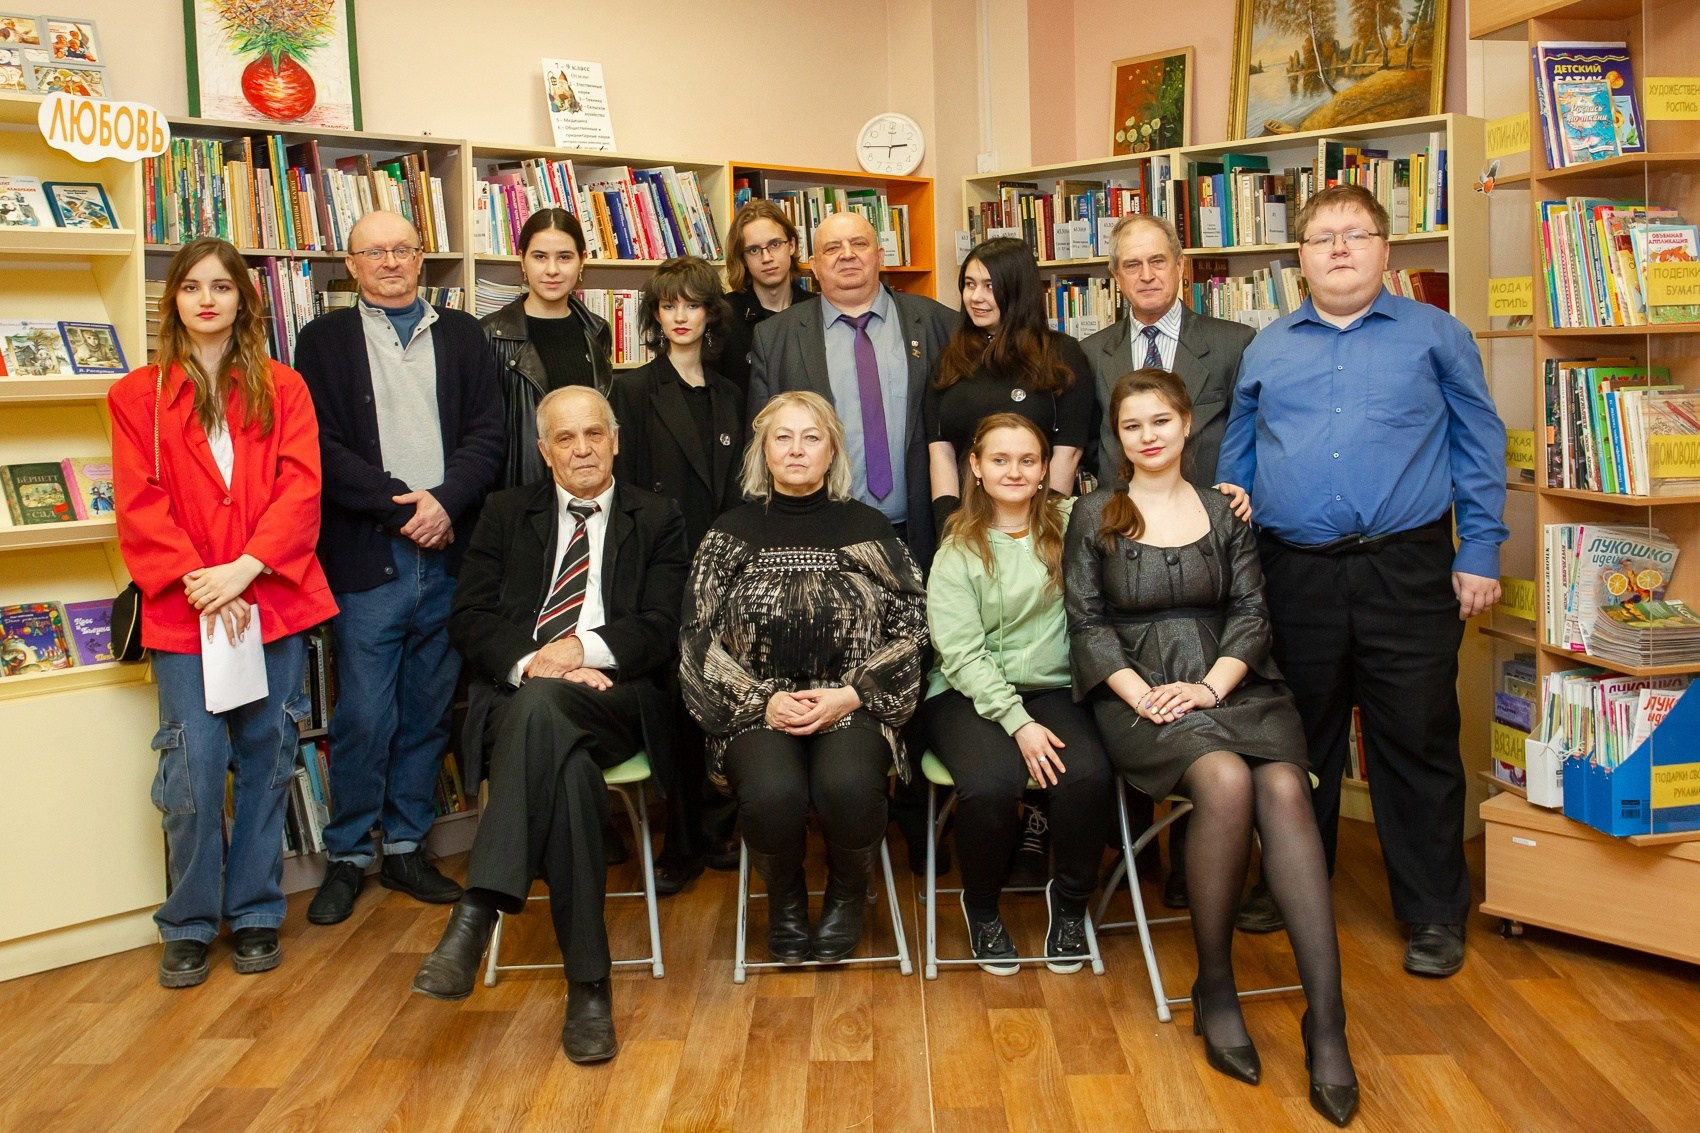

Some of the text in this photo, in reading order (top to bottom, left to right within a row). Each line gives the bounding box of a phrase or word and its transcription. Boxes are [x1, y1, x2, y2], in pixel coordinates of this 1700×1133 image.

[1554, 64, 1602, 74] ДЕТСКИЙ
[1571, 104, 1603, 113] Роспись
[1666, 102, 1698, 112] РОСПИСЬ
[49, 98, 164, 152] ЛЮБОВЬ
[907, 132, 913, 140] 2
[1488, 120, 1530, 152] КУЛИНАРИЯ
[912, 143, 918, 152] 3
[897, 162, 903, 170] 5
[293, 205, 303, 243] БАБУШКИНЫ
[1490, 281, 1532, 294] МОДА И
[1495, 298, 1528, 308] СТИЛЬ
[1506, 451, 1534, 464] УШКА
[1587, 538, 1673, 564] ЛУКОШКО
[1592, 554, 1619, 567] идей
[1502, 582, 1536, 612] ШИВКА
[1655, 770, 1688, 784] ПОДАРКИ
